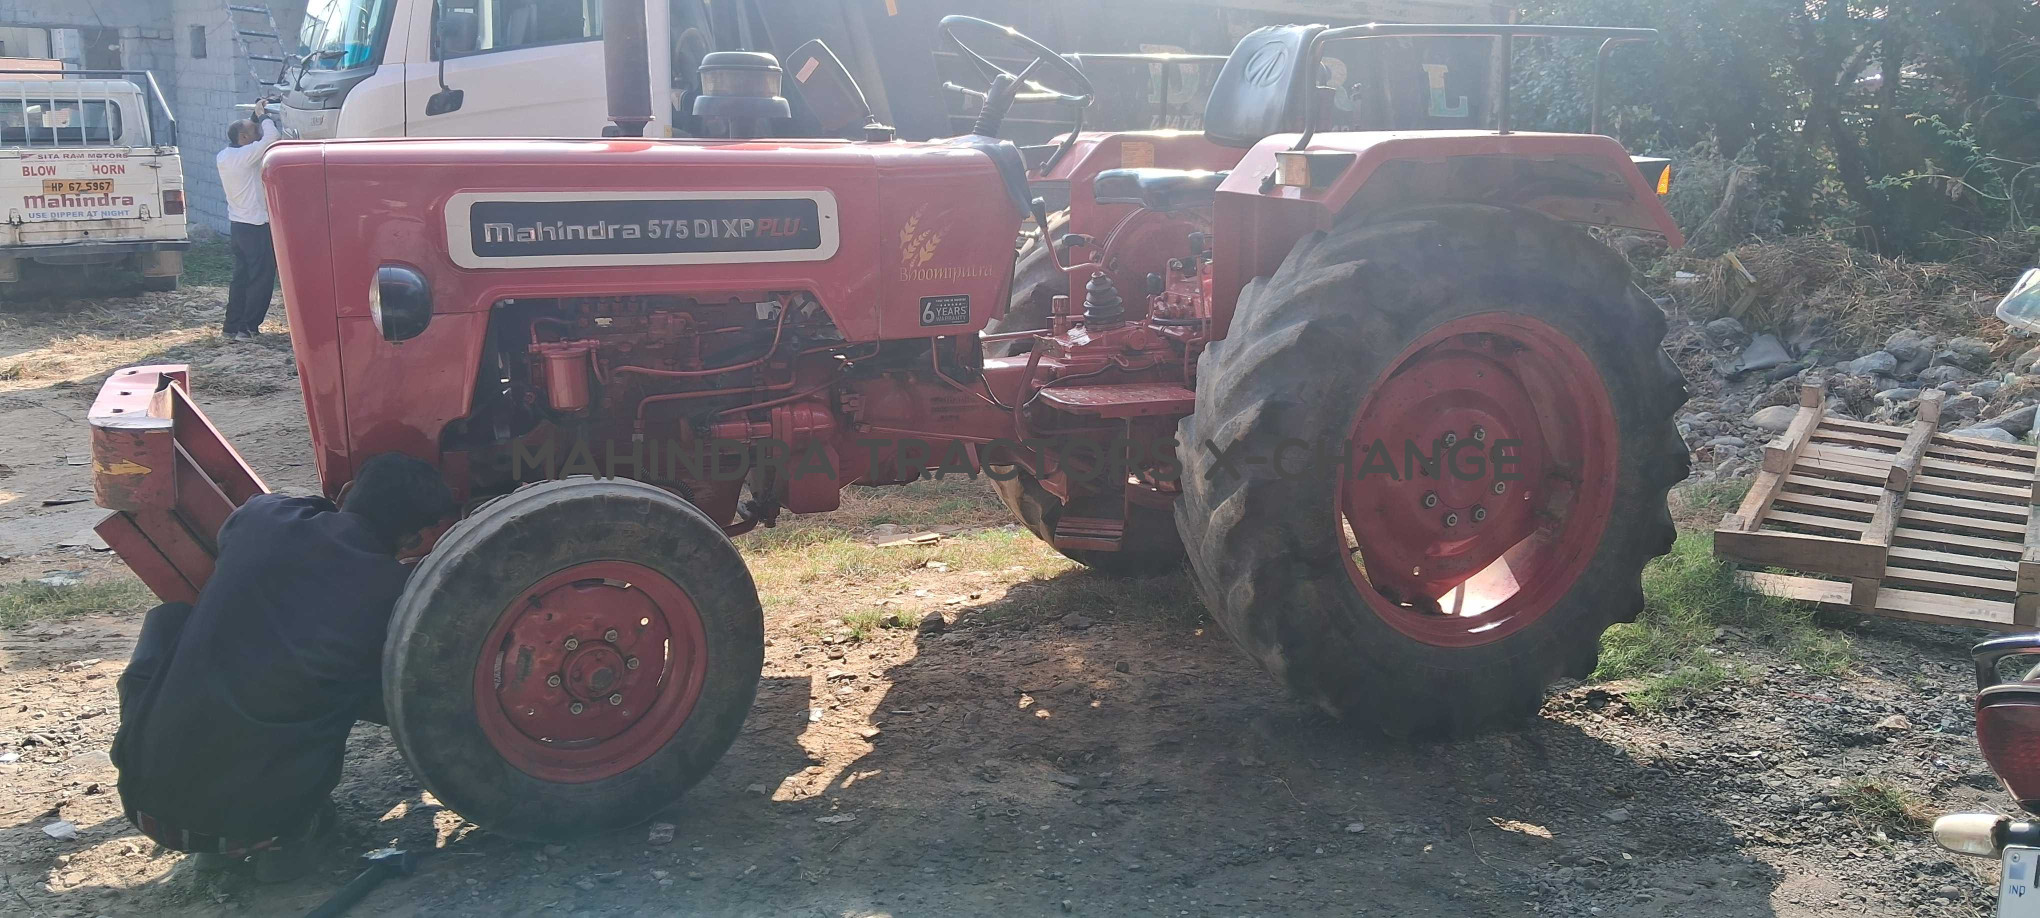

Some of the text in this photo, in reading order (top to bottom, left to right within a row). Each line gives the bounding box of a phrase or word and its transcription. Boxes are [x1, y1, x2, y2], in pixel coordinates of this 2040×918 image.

[1422, 64, 1468, 118] L
[22, 164, 125, 176] BLOW HORN
[51, 182, 111, 192] HP 67 5967
[87, 210, 98, 218] AT
[648, 219, 689, 239] 575
[694, 219, 718, 239] DI
[722, 218, 754, 238] XP
[756, 217, 808, 238] PLU
[922, 302, 935, 324] 6
[936, 306, 967, 316] YEARS
